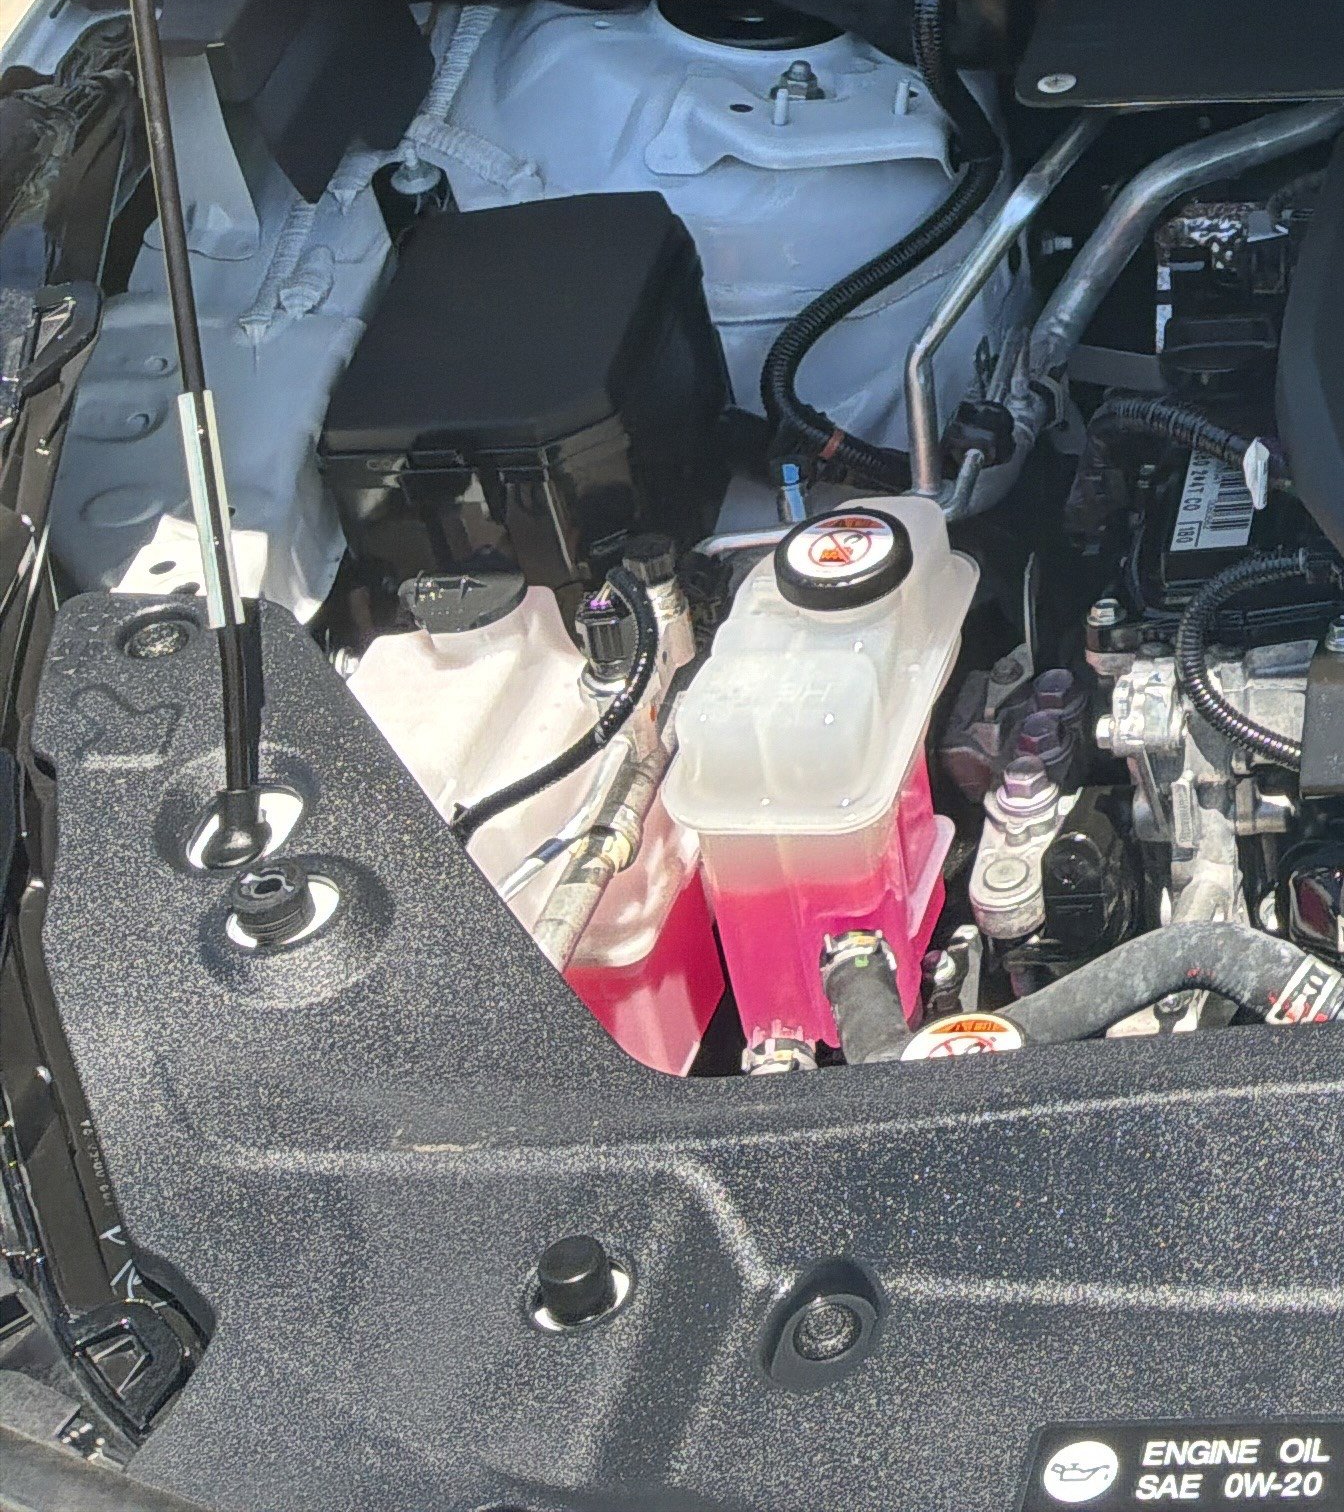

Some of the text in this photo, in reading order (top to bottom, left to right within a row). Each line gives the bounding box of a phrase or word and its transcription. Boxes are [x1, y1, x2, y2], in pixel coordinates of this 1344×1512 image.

[1142, 1438, 1331, 1466] ENGINE OIL
[1135, 1472, 1324, 1500] SAE 0W-20
